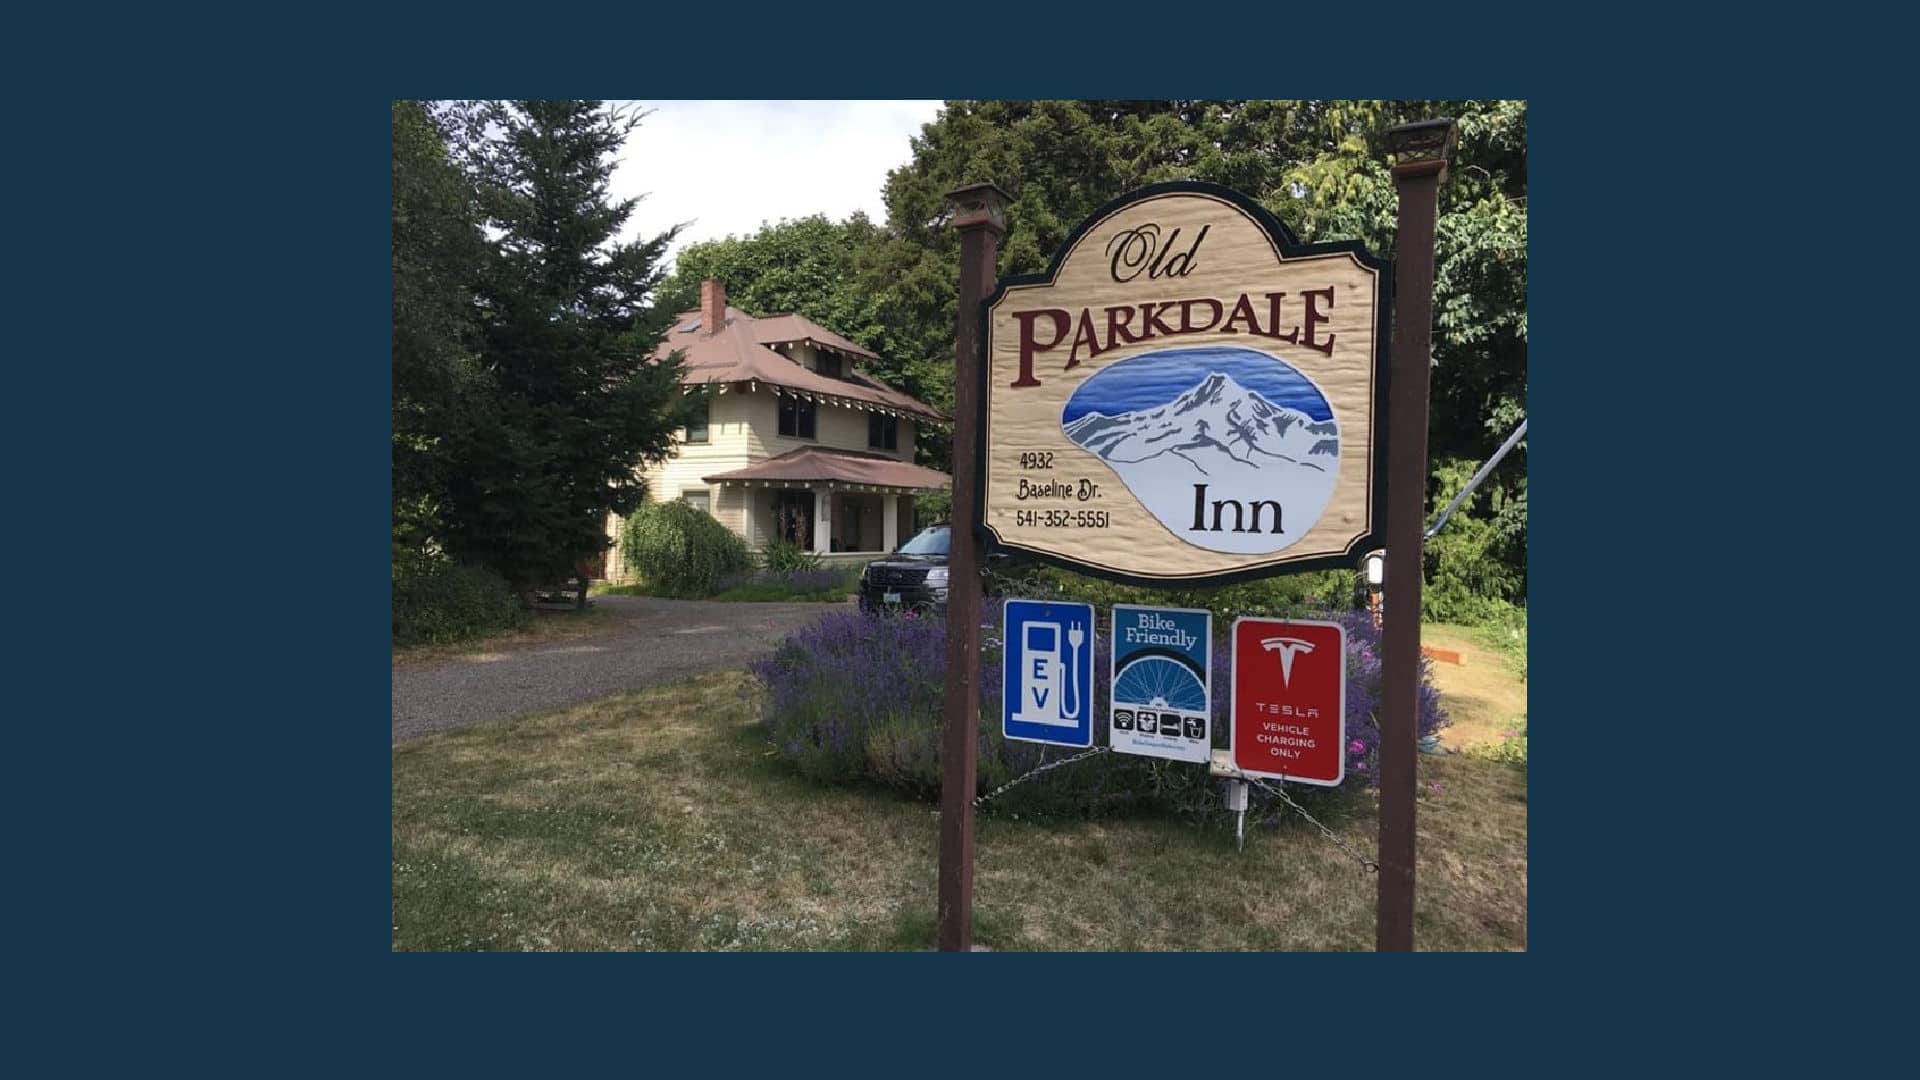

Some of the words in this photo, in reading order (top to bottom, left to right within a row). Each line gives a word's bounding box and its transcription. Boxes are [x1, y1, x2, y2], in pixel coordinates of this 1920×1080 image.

[1105, 223, 1210, 283] Old
[1010, 285, 1336, 388] PARKDALE
[1019, 452, 1053, 469] 4932
[1016, 478, 1073, 500] Baseline
[1077, 478, 1102, 500] Dr.
[1189, 484, 1285, 534] Inn
[1016, 510, 1110, 529] 541-352-5551
[1138, 613, 1175, 631] Bike
[1126, 627, 1197, 650] Friendly
[1256, 702, 1320, 719] TESLA
[1263, 722, 1309, 736] VEHICLE
[1257, 734, 1316, 749] CHARGING
[1270, 747, 1301, 759] ONLY
